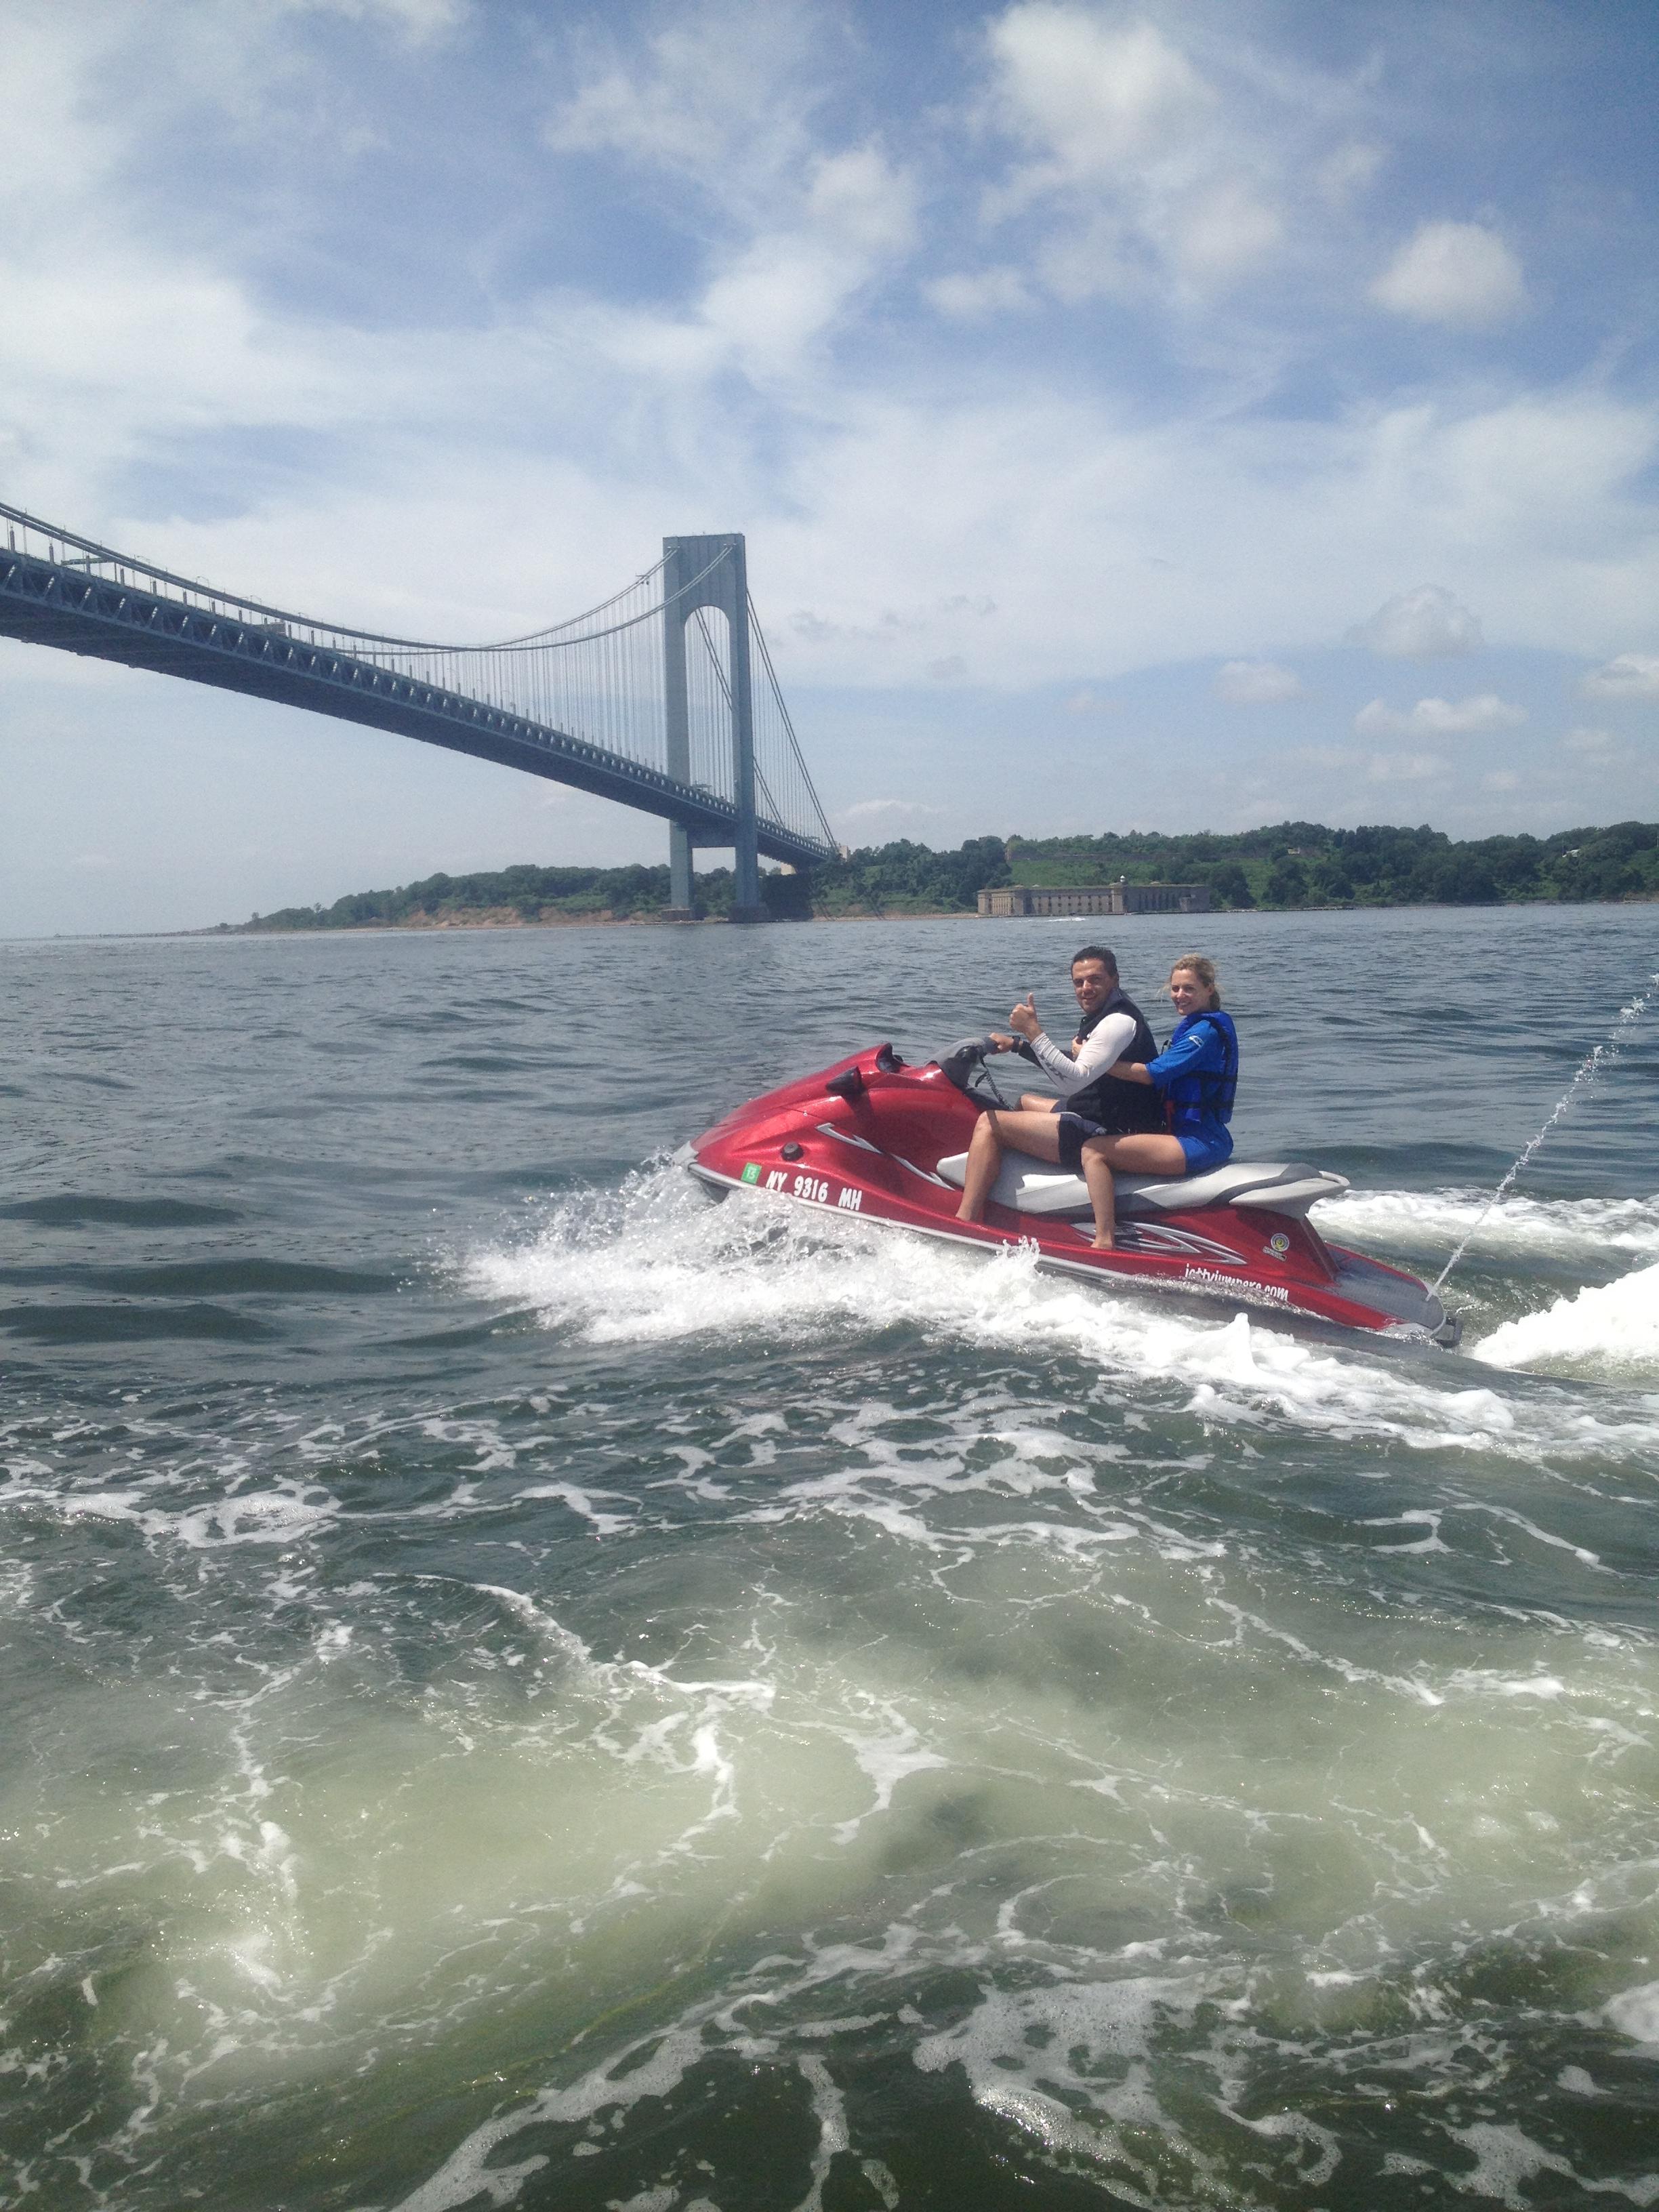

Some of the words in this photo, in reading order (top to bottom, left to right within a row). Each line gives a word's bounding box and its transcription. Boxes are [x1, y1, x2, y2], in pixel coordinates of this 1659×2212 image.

[765, 1170, 788, 1191] NY
[794, 1176, 829, 1202] 9316
[838, 1187, 862, 1211] MH
[1185, 1263, 1289, 1301] jettyjumperscom
